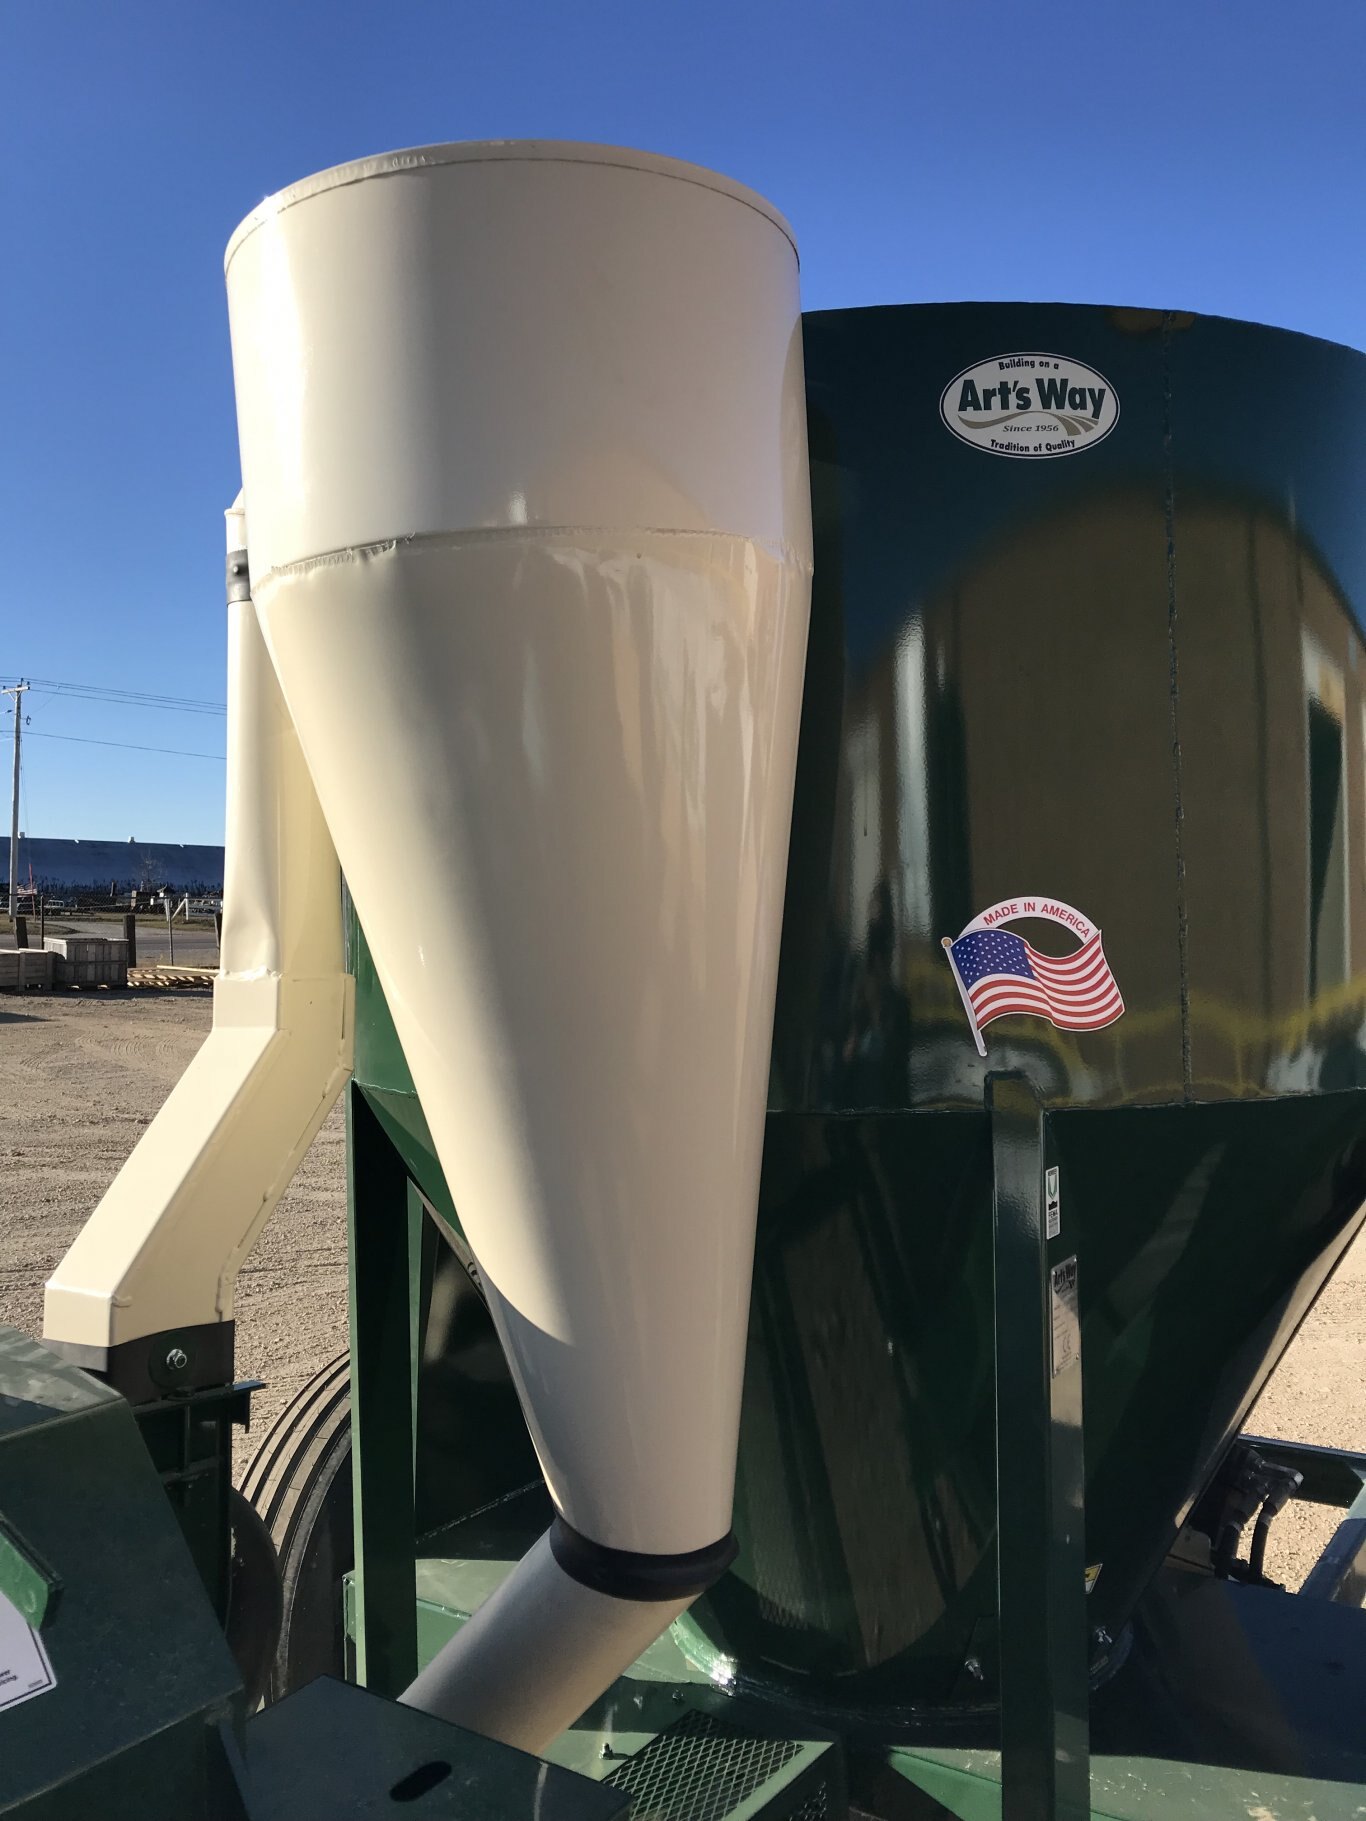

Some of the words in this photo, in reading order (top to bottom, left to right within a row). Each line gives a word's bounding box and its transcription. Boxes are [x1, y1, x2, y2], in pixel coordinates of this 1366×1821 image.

[998, 358, 1035, 370] Building
[1039, 360, 1050, 369] on
[1053, 362, 1059, 370] a
[958, 379, 1031, 411] Art's
[1035, 378, 1106, 419] Way
[1003, 424, 1032, 432] Since
[1034, 424, 1059, 432] 1956
[990, 439, 1030, 453] Tradition
[1033, 442, 1043, 452] of
[1045, 439, 1076, 451] Quality
[983, 903, 1019, 926] MADE
[1023, 902, 1036, 912] IN
[1040, 903, 1090, 938] AMERICA
